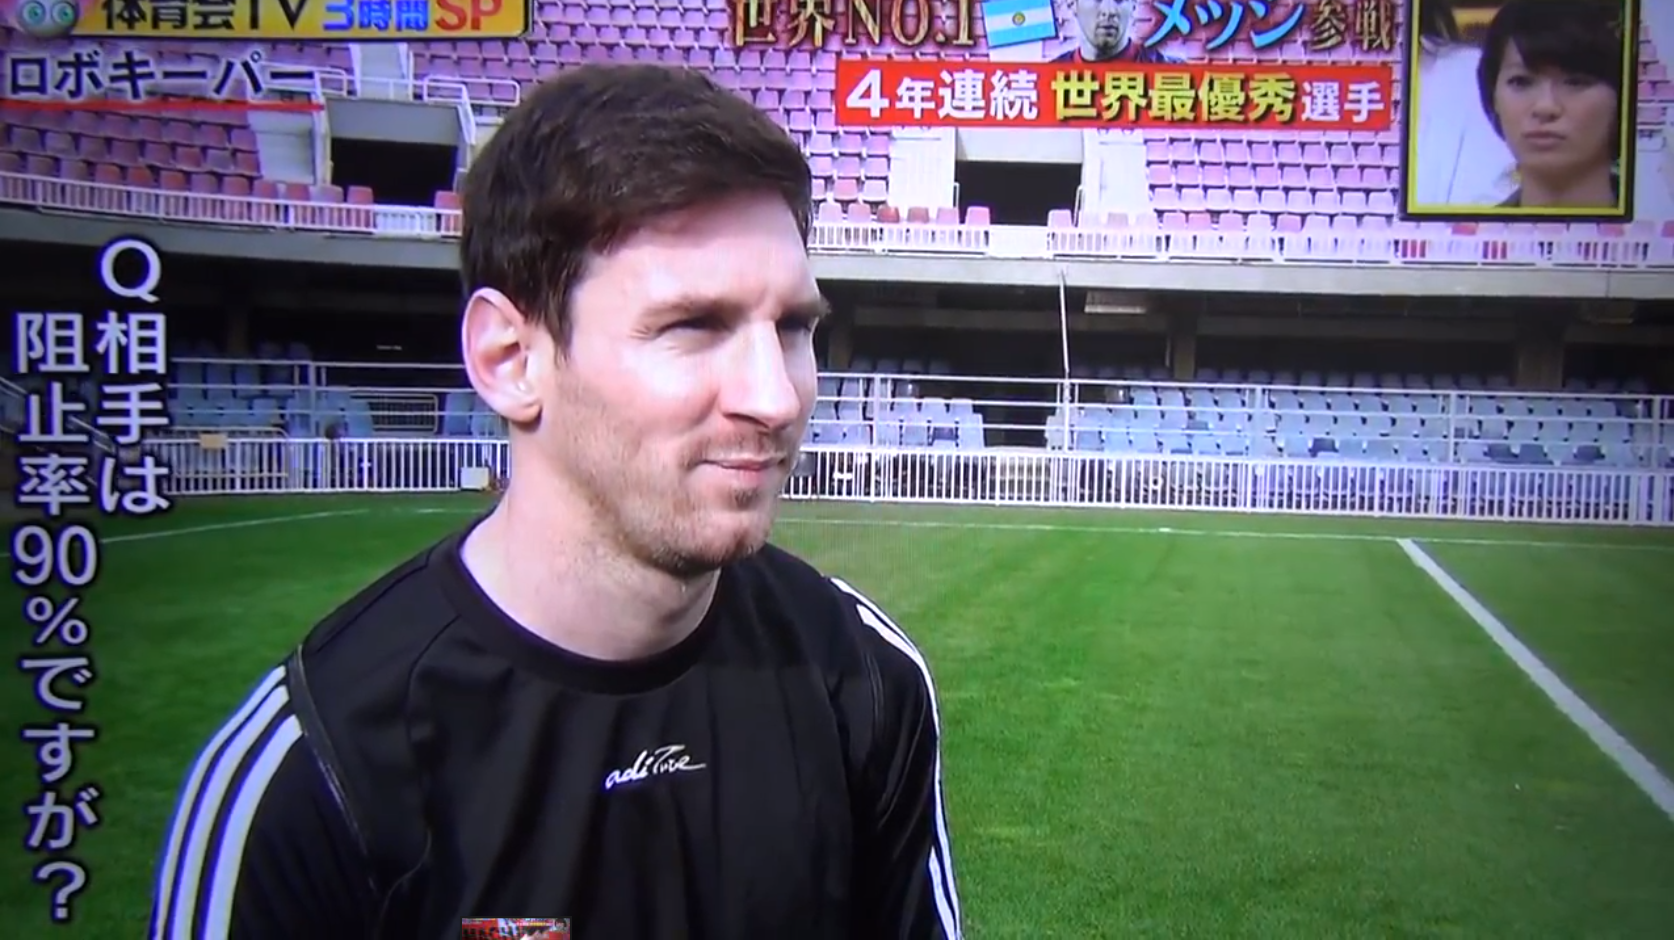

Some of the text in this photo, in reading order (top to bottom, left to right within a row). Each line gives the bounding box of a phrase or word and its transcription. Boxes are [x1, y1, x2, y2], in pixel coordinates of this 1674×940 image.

[8, 49, 316, 100] ロボキーパー
[845, 68, 1385, 123] 4年連続 世界最優秀選手
[95, 238, 170, 514] Q相手は
